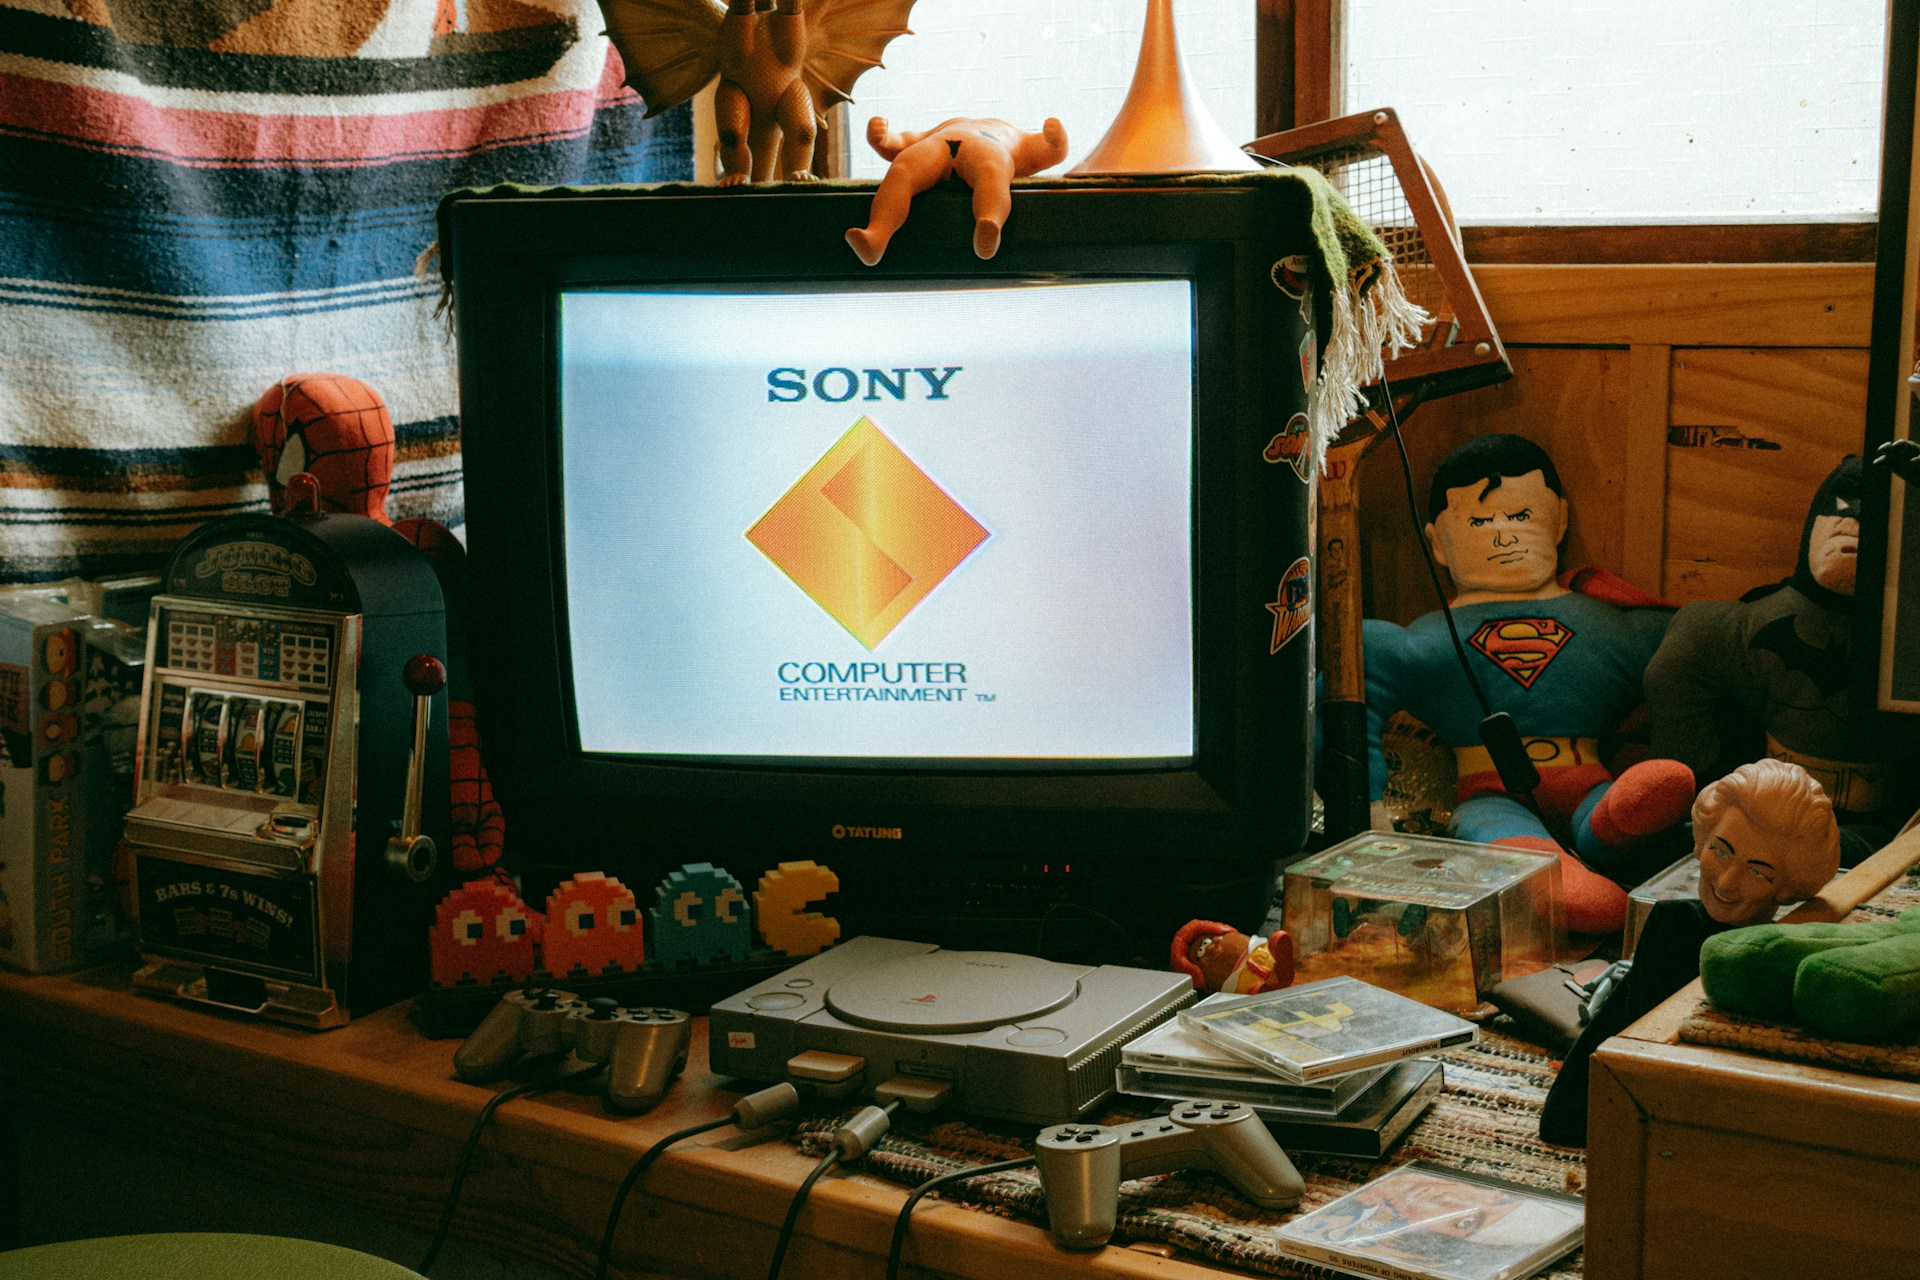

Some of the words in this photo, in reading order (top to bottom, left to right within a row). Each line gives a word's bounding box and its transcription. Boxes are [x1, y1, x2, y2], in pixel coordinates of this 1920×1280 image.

[766, 366, 964, 403] SONY
[222, 571, 291, 598] SLOT
[777, 662, 967, 684] COMPUTER
[779, 687, 968, 703] ENTERTAINMENT
[975, 693, 996, 702] TM
[47, 794, 71, 865] PARK
[846, 825, 903, 841] TATUNG
[154, 881, 202, 903] BARS
[242, 890, 294, 928] WINS!
[47, 872, 73, 960] SOUTH
[920, 1049, 928, 1059] 2
[1402, 1043, 1438, 1056] RUNABOUT
[1341, 1258, 1378, 1274] FIGHTERS
[1380, 1269, 1391, 1277] OF
